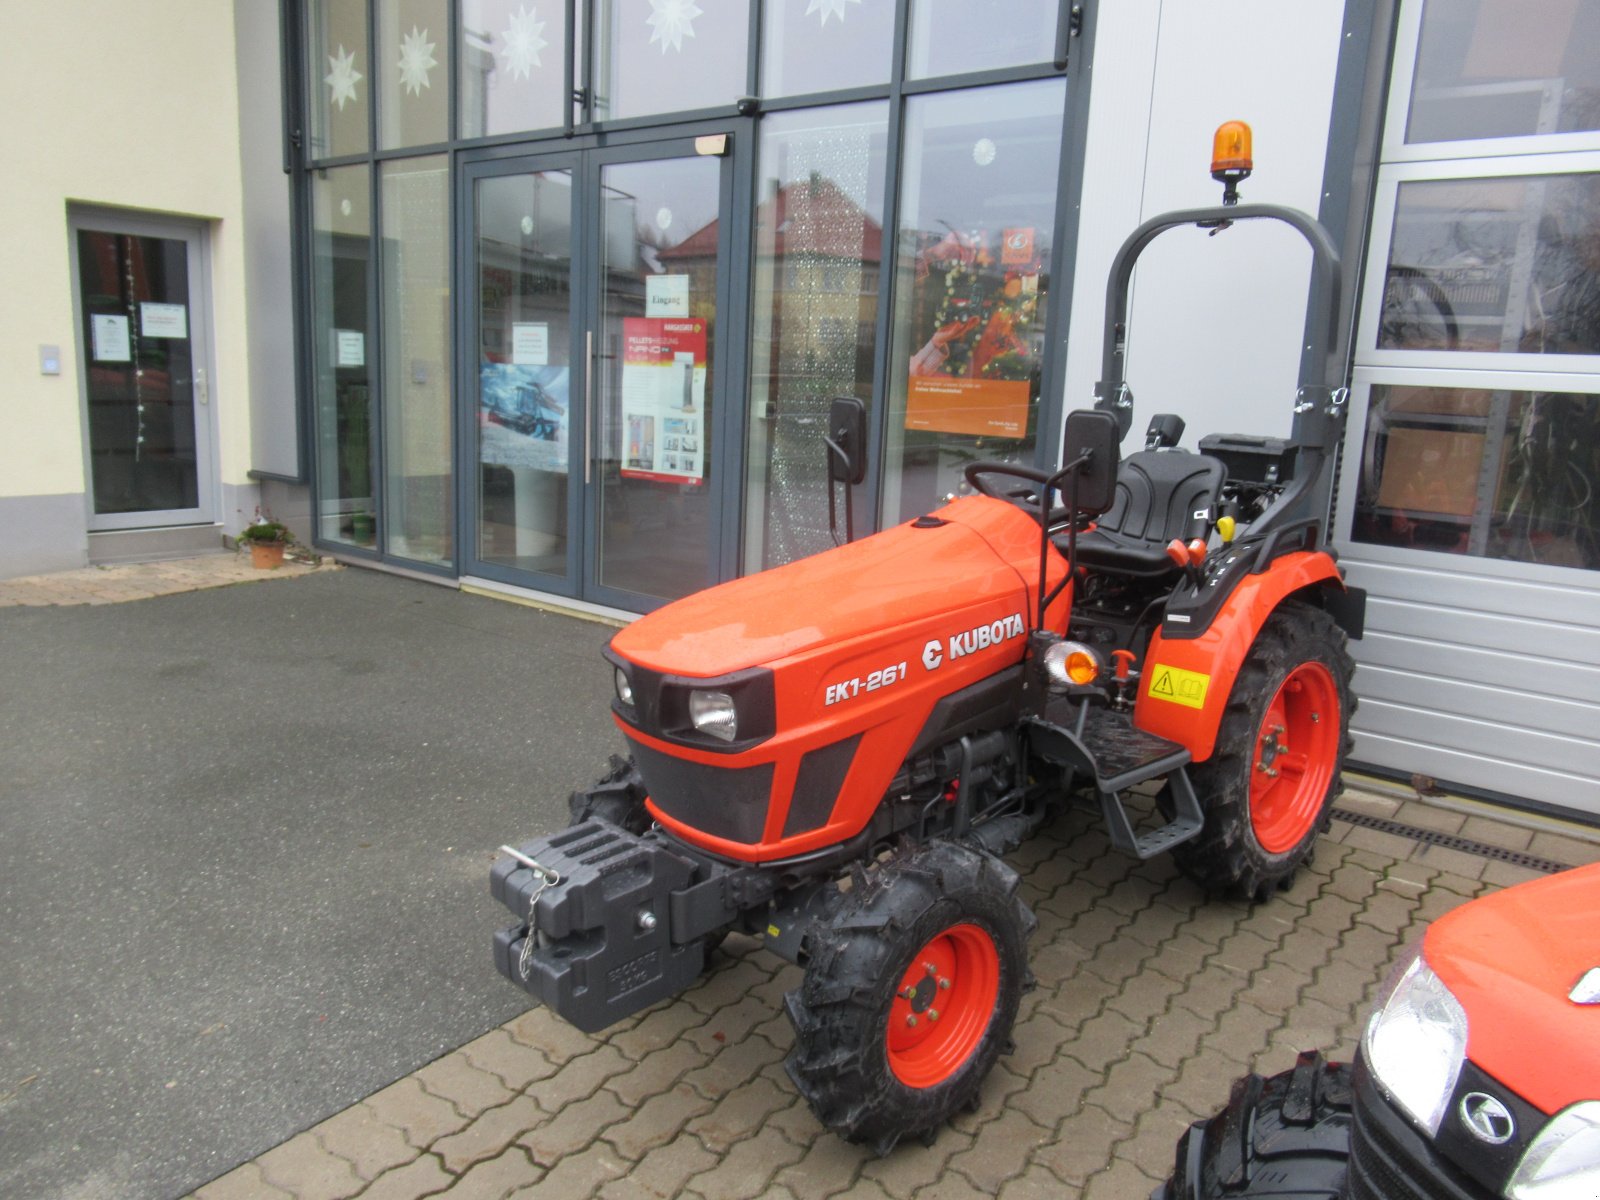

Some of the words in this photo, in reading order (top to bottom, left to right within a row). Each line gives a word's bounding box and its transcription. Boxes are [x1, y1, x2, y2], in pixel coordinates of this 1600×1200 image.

[652, 295, 681, 305] Eingang
[949, 613, 1025, 660] KUBOTA
[824, 661, 907, 706] EK1-261
